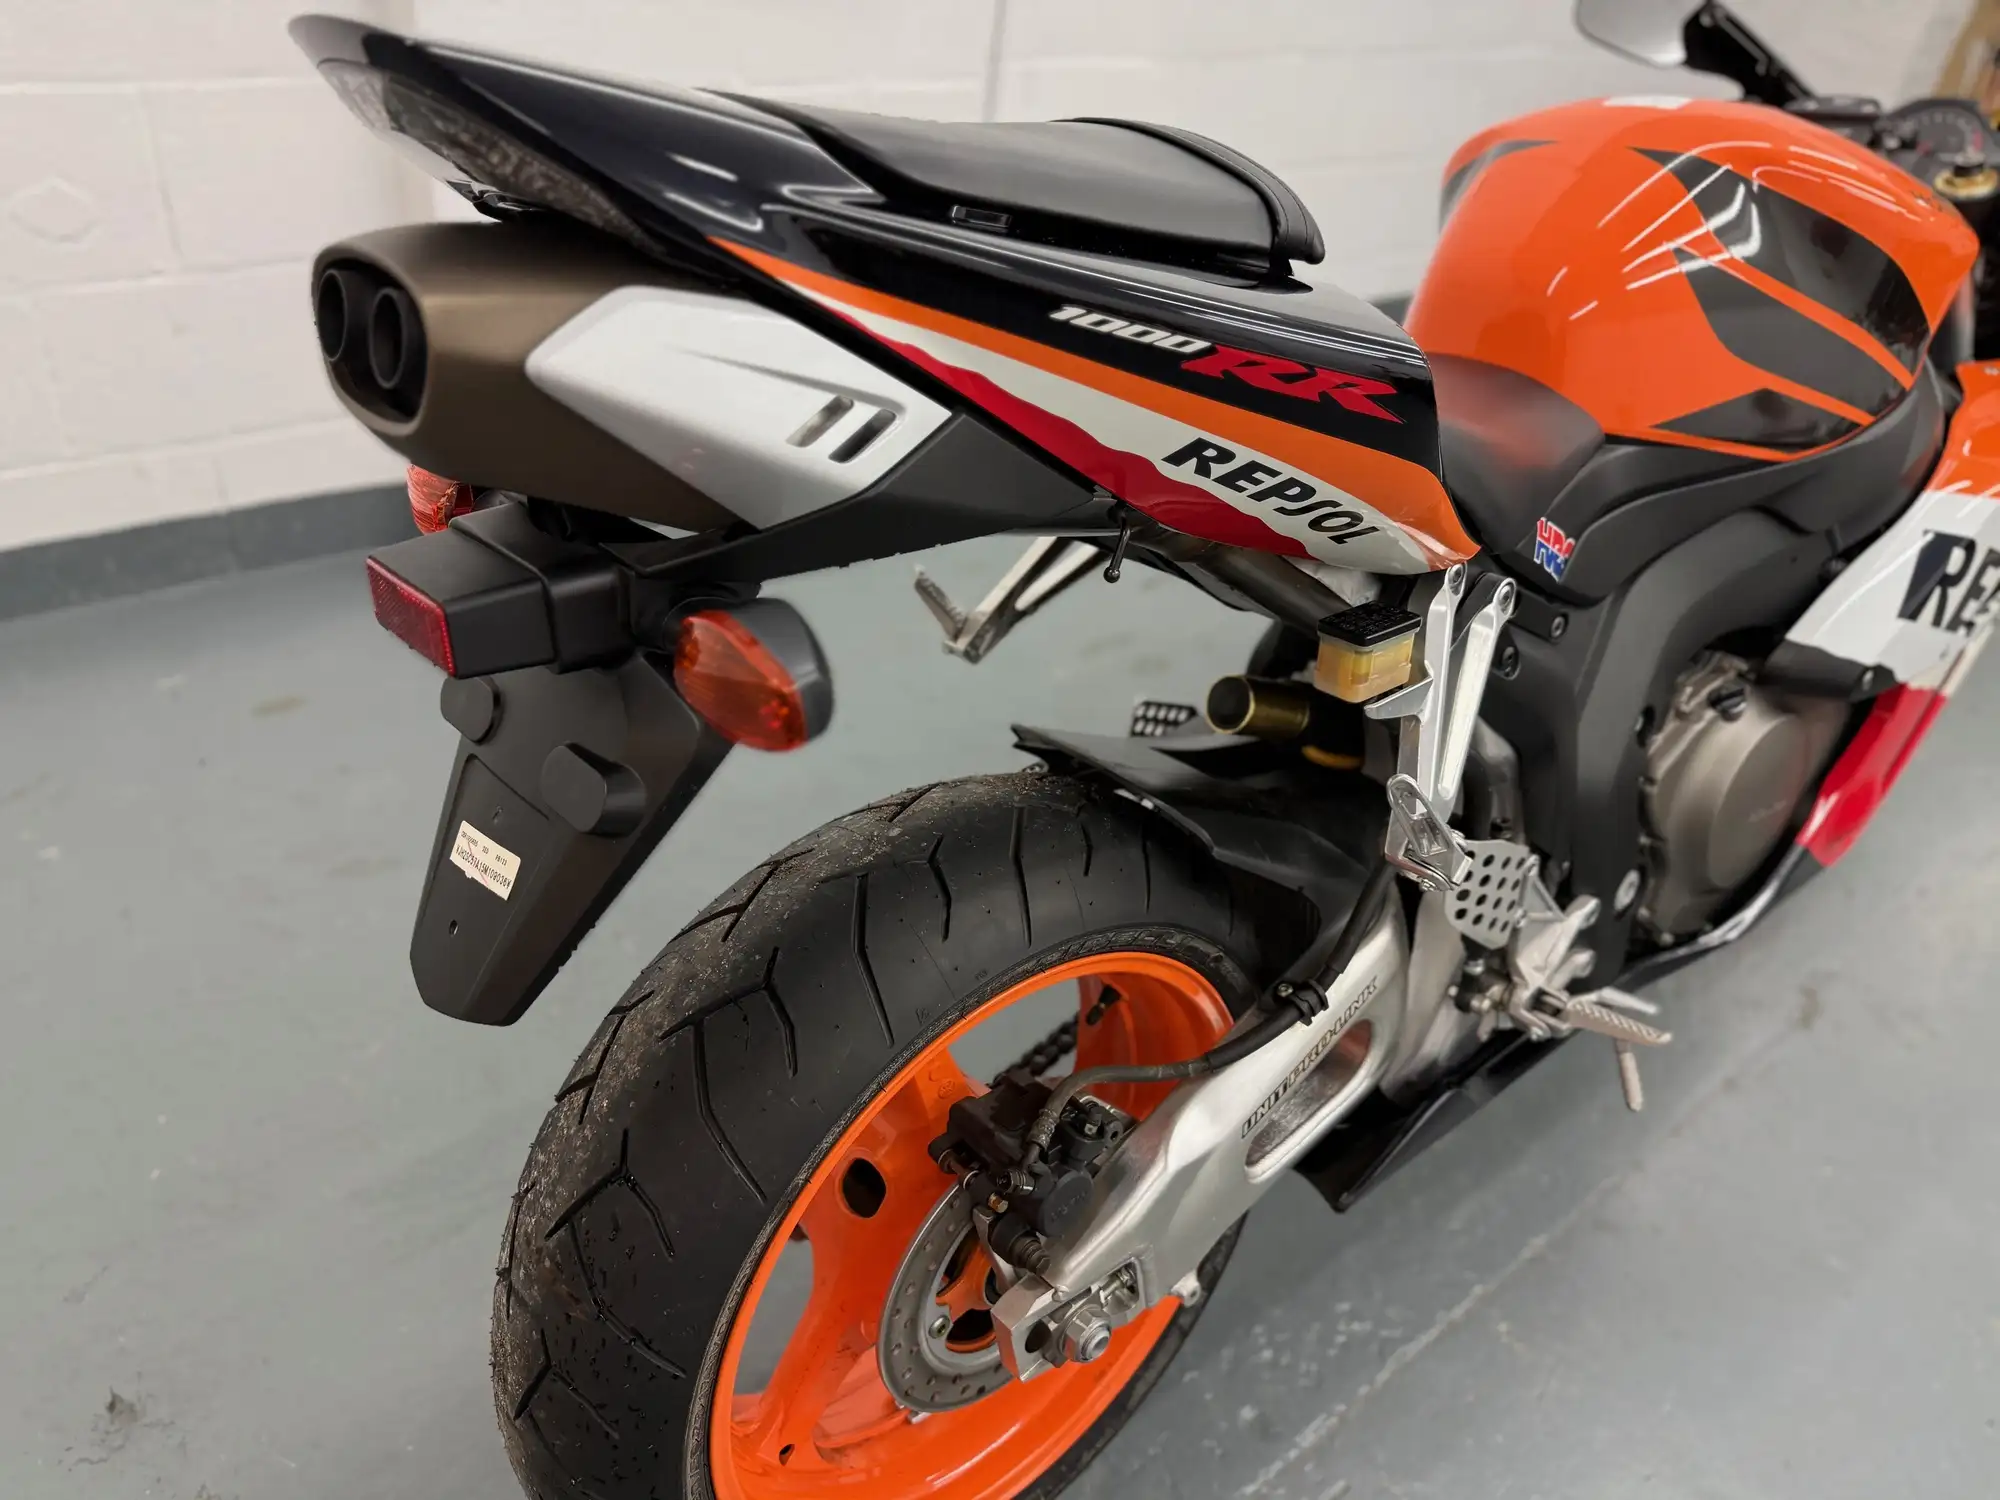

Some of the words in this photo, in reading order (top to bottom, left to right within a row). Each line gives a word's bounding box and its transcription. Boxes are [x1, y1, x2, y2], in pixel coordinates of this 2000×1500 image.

[1049, 304, 1213, 355] 1000
[1180, 344, 1404, 424] RR
[1161, 437, 1380, 545] REPSOL
